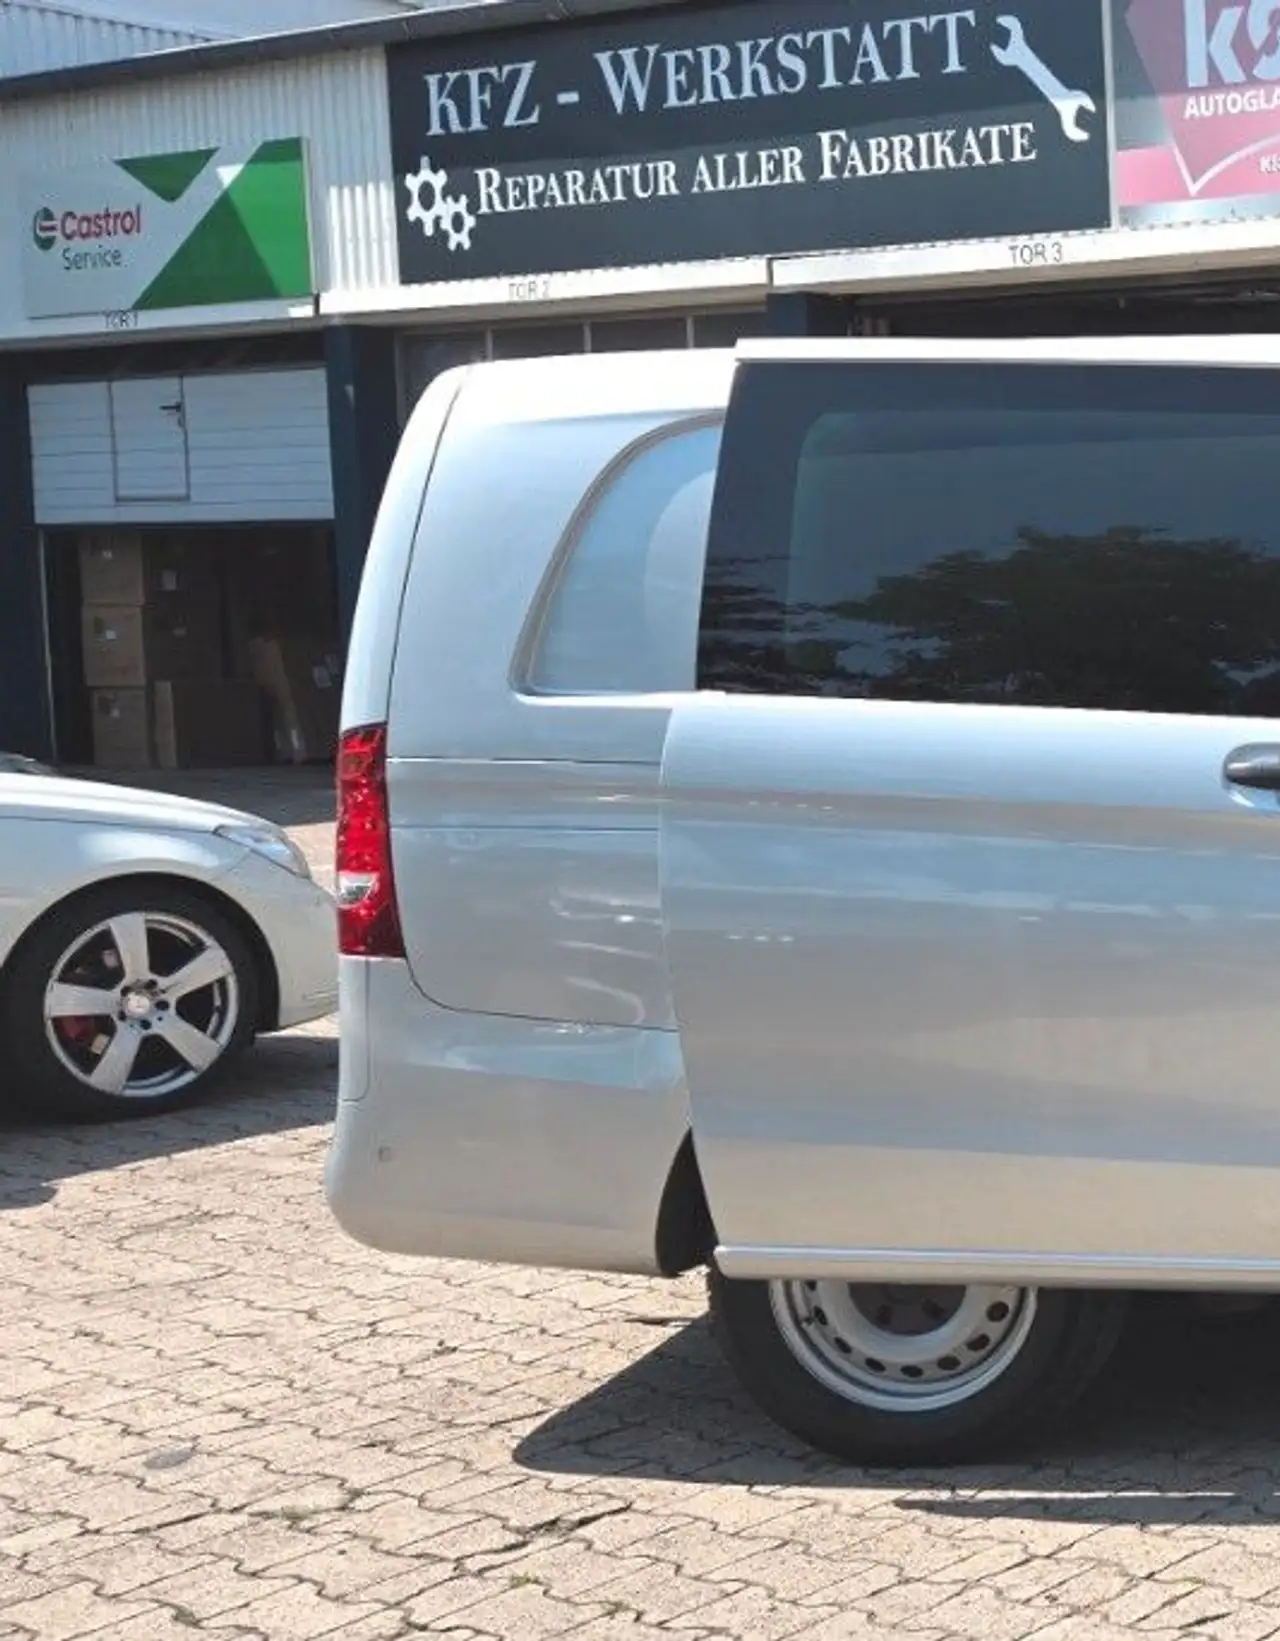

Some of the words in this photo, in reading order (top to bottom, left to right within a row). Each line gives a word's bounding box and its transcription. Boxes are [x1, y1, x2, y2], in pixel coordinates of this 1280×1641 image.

[424, 60, 541, 136] KFZ
[594, 10, 976, 115] WERKSTATT
[474, 160, 679, 215] REPARATUR
[692, 145, 805, 194] ALLER
[817, 121, 1037, 182] FABRIKATE
[61, 203, 141, 240] Castrol
[62, 244, 122, 270] Service
[1008, 242, 1048, 265] TOR
[1051, 240, 1063, 263] 3
[508, 281, 538, 301] TOR
